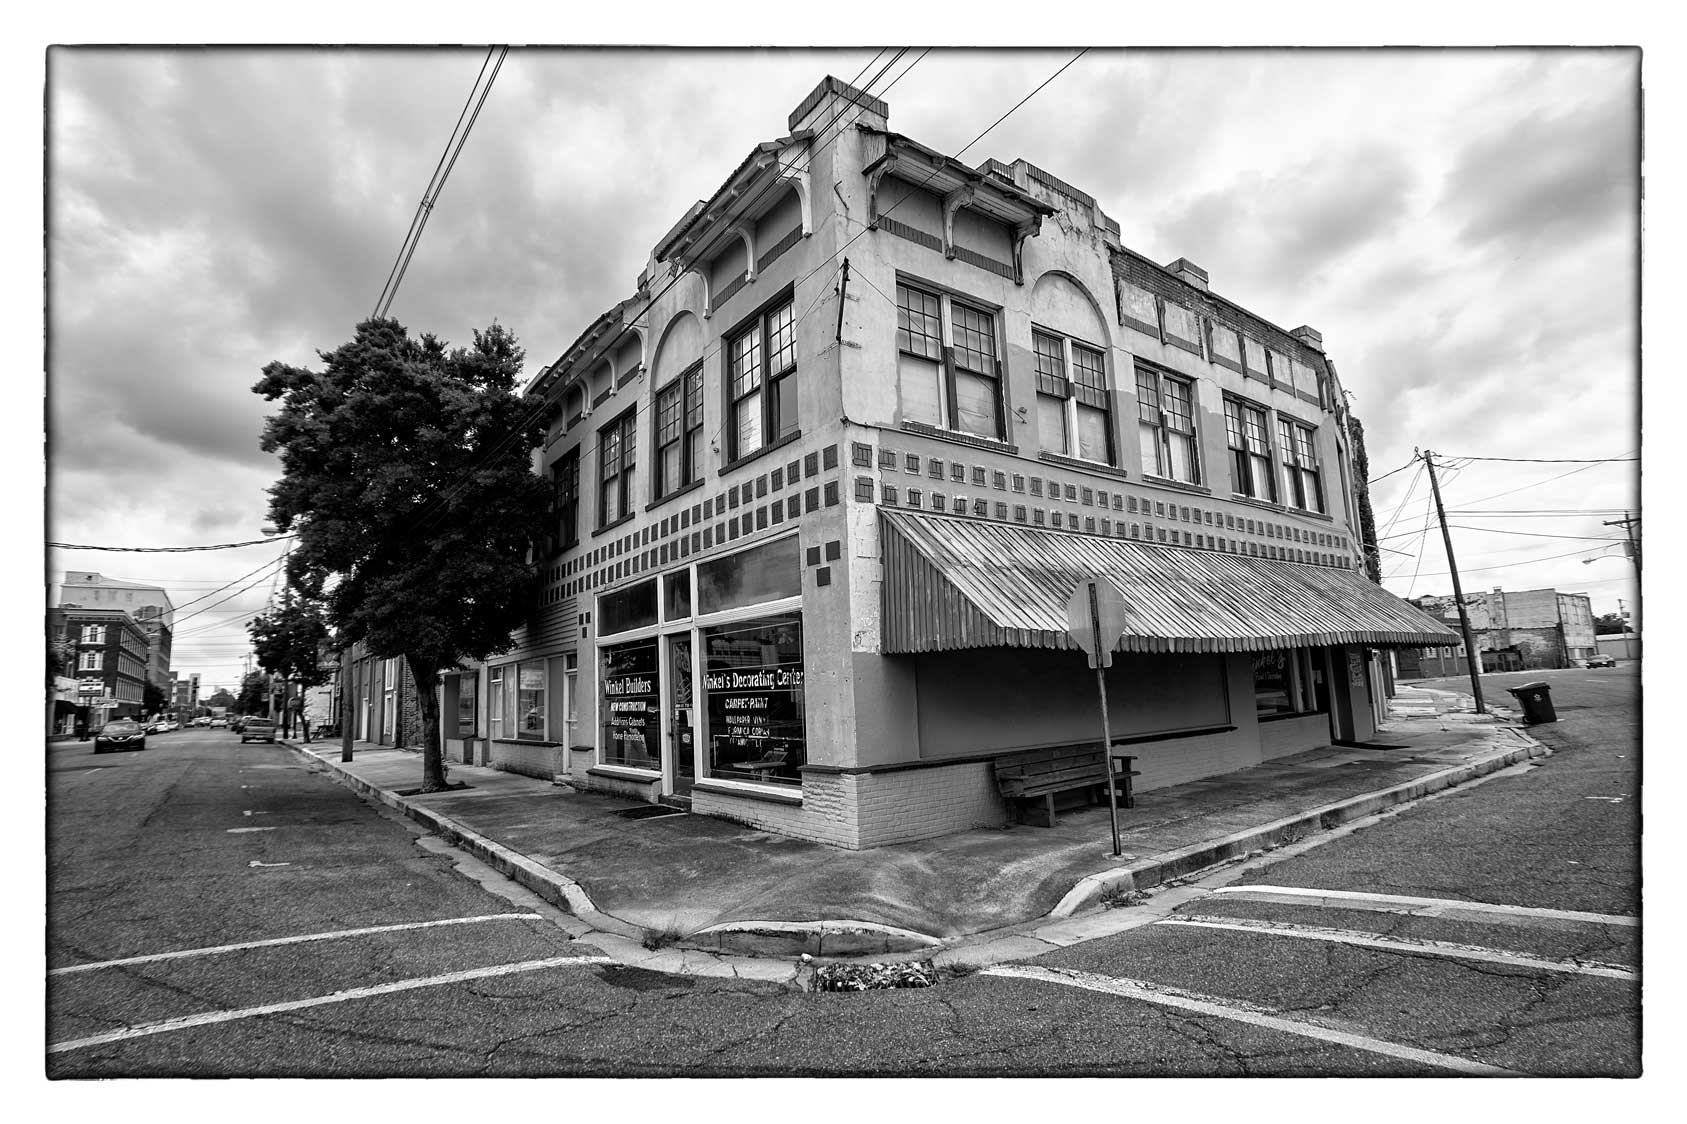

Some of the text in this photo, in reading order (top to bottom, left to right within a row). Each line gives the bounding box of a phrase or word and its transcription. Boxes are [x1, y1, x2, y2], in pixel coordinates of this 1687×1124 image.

[604, 677, 652, 695] Winkel Builders
[732, 670, 775, 690] Decorating
